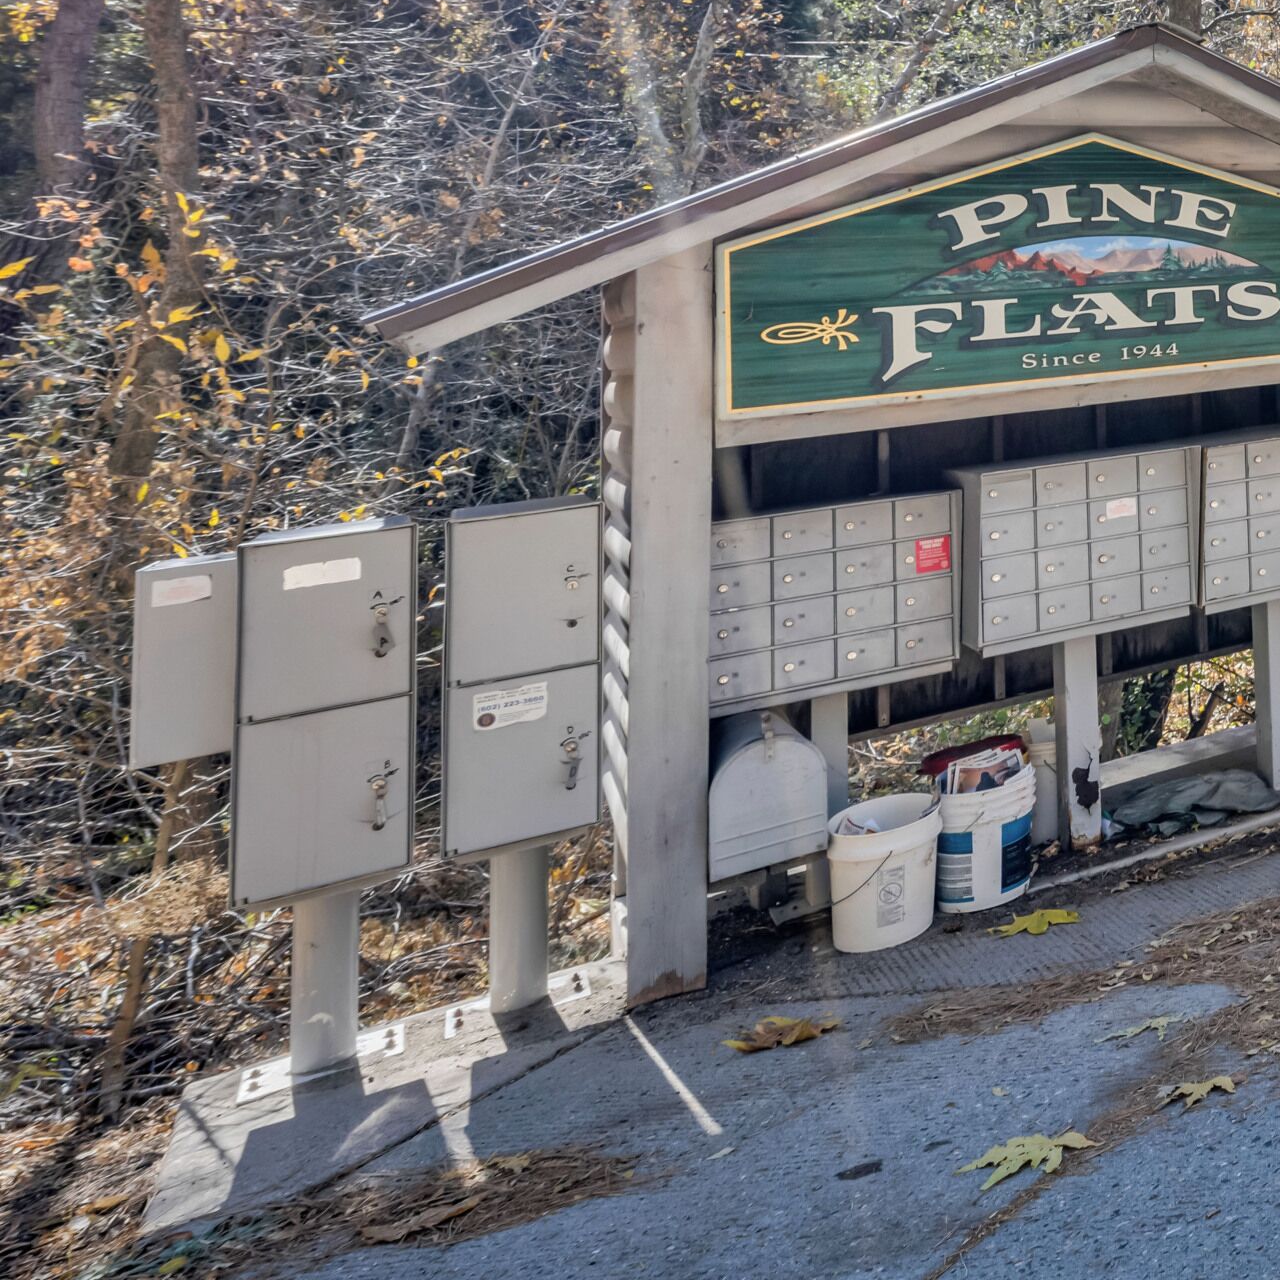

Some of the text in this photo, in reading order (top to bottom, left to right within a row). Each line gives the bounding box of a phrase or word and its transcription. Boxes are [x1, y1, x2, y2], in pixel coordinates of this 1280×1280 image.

[936, 183, 1238, 251] PINE
[1021, 342, 1180, 369] Since 1944
